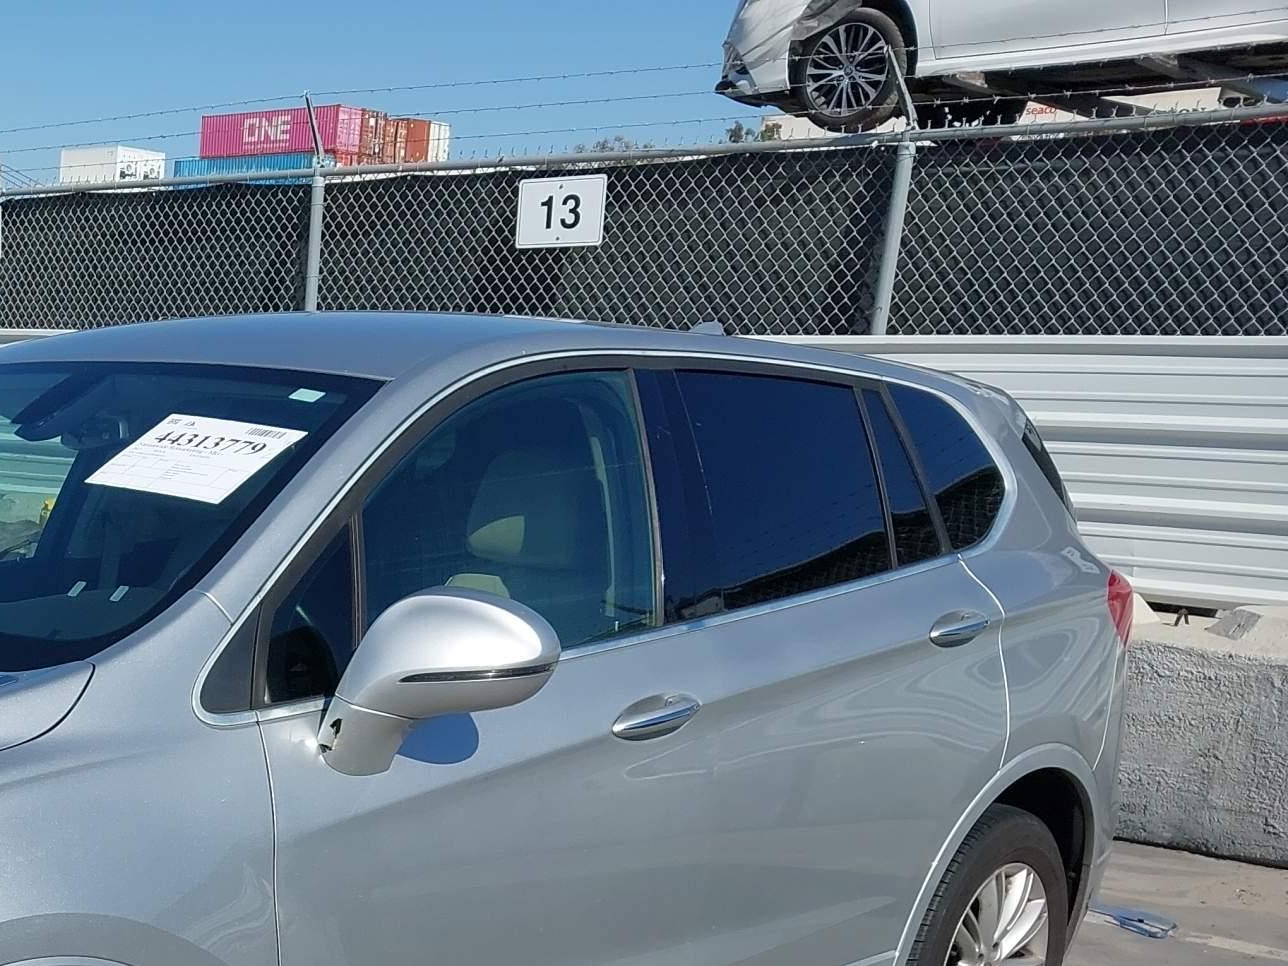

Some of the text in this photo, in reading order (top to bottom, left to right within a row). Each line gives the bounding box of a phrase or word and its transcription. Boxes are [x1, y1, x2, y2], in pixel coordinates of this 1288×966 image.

[243, 115, 291, 142] ONE
[540, 194, 581, 230] 13
[155, 430, 267, 455] 44313779
